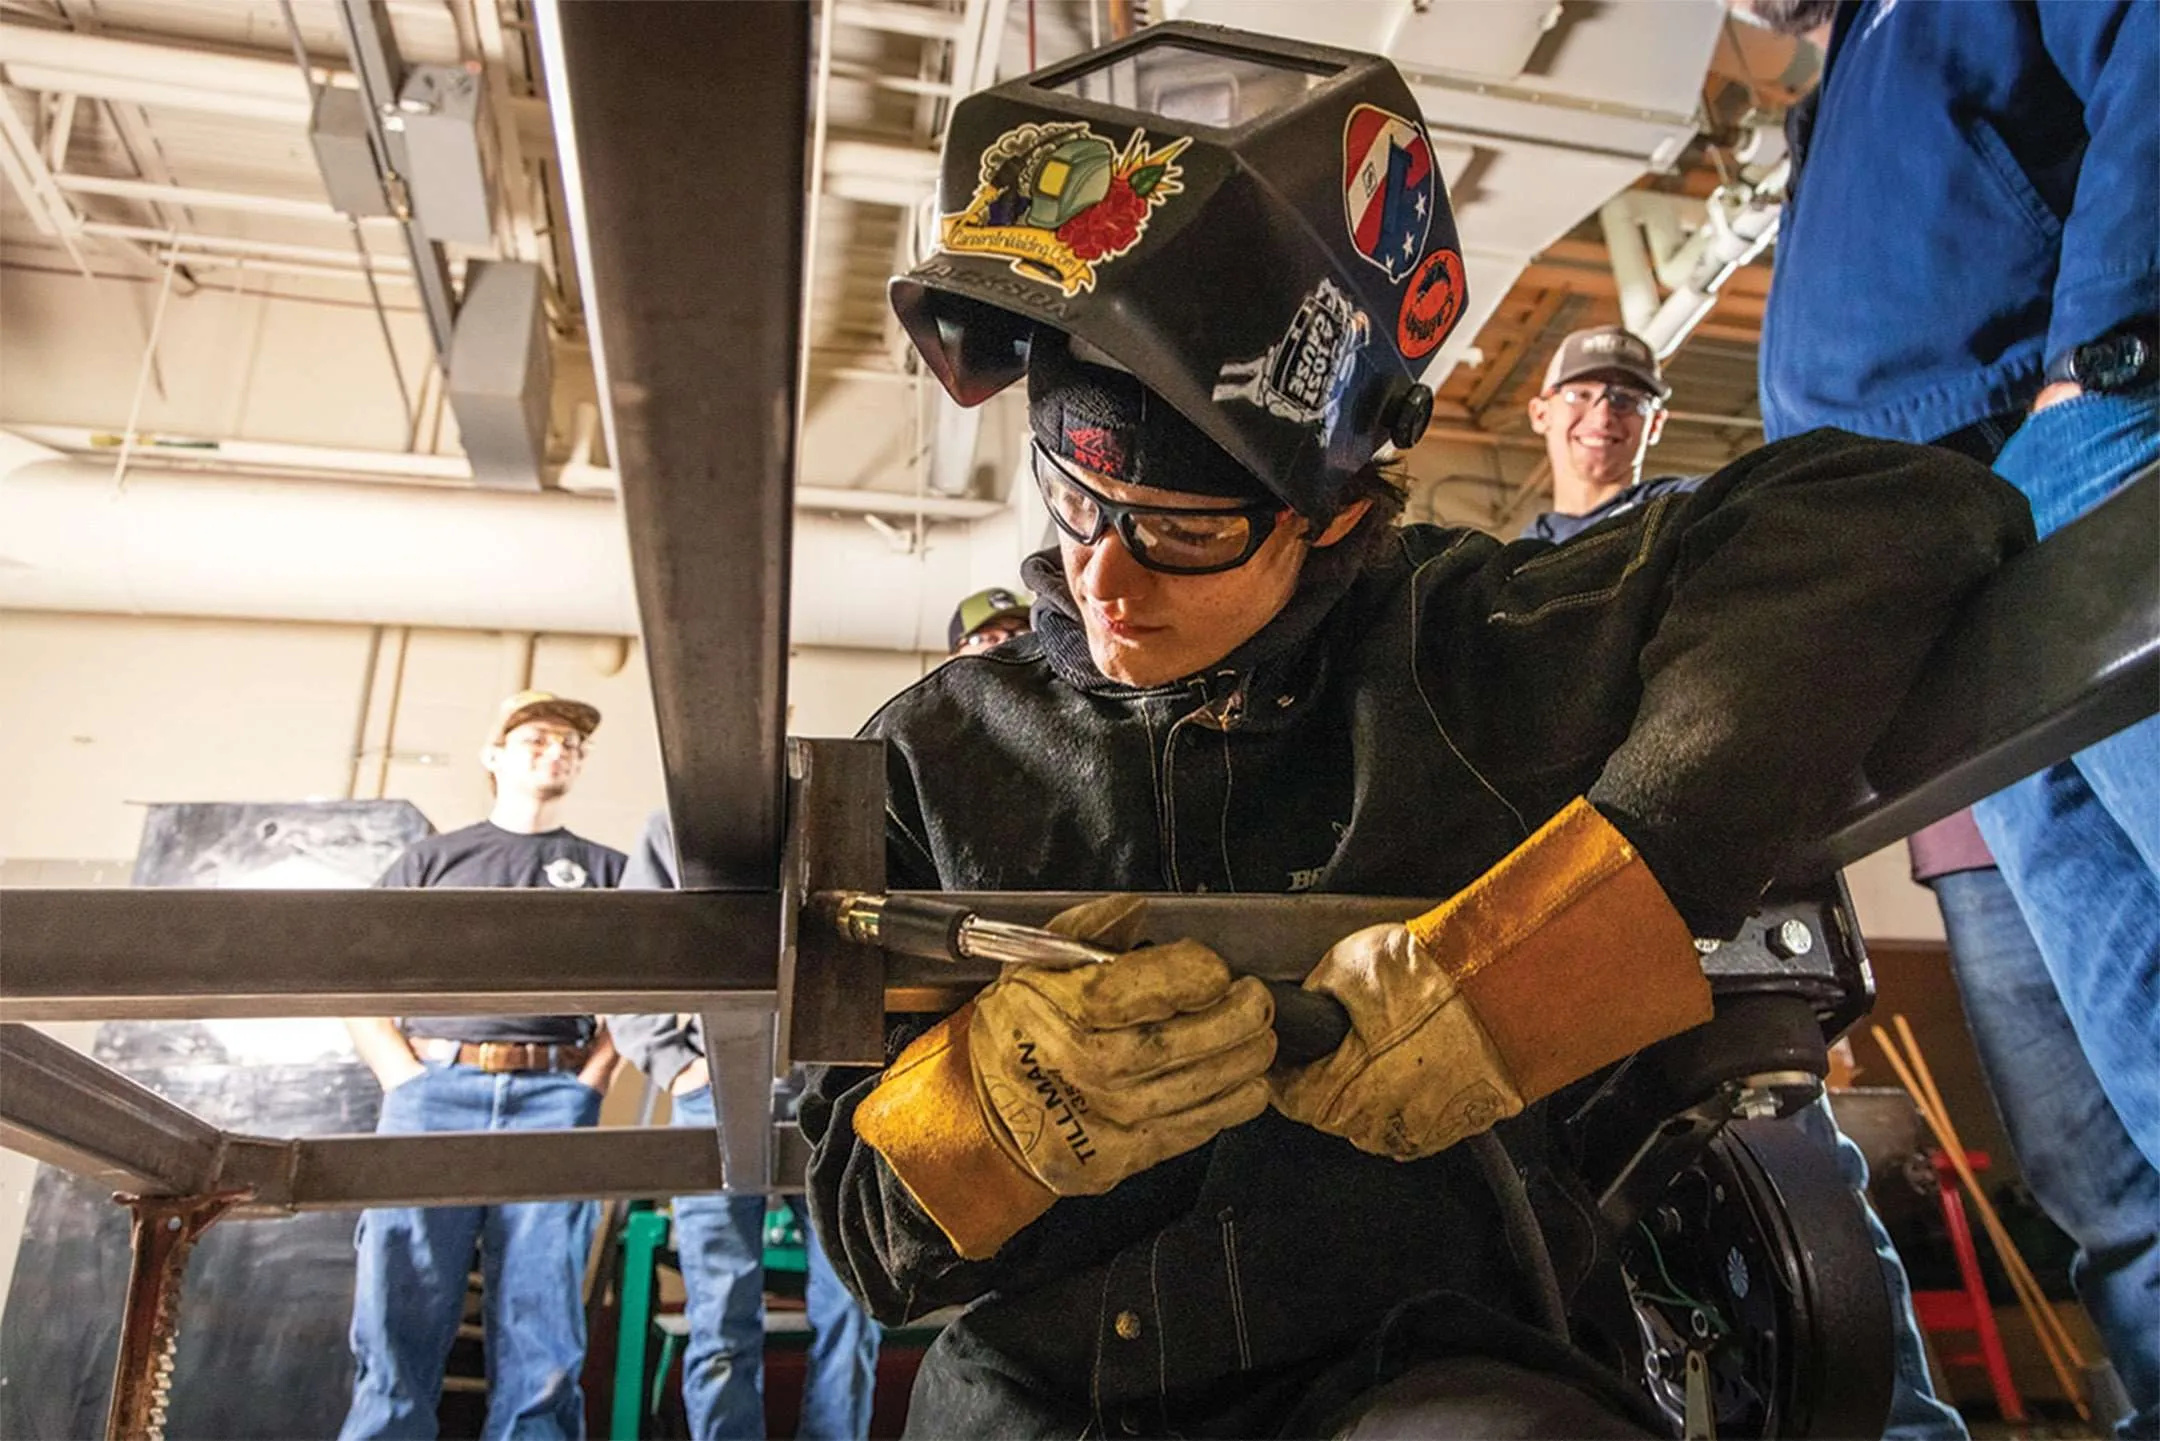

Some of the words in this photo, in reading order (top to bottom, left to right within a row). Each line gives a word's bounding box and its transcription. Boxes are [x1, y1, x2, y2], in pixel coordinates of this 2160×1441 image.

[1288, 313, 1325, 396] CAUSE
[1304, 345, 1331, 405] LOST
[1018, 1043, 1096, 1165] TILLMAN
